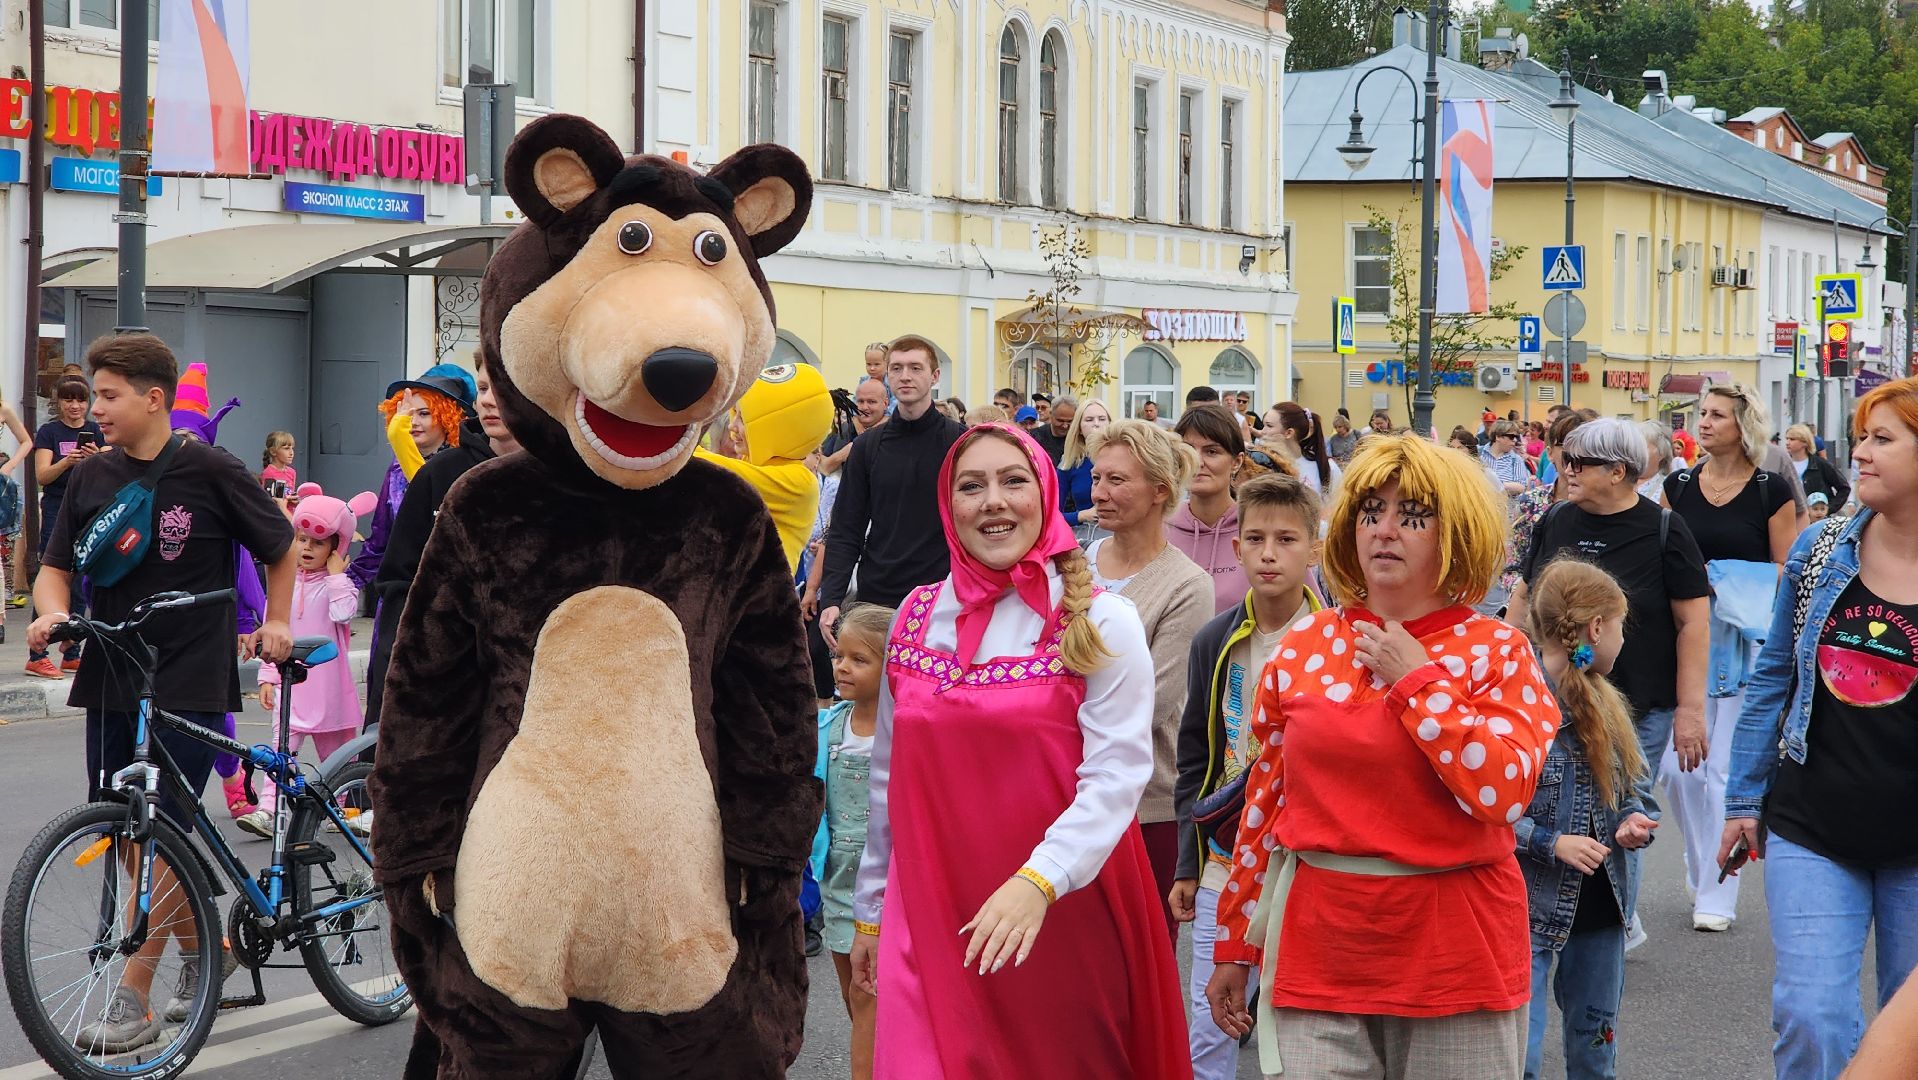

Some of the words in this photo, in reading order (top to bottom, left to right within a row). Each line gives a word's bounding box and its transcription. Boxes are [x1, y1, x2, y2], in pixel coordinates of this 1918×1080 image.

[302, 190, 344, 207] ЭКОНОМ
[345, 194, 376, 211] КЛАСС
[377, 198, 383, 211] 2
[384, 199, 409, 213] ЭТАЖ
[1142, 309, 1248, 341] ХОЗЯЮШКА
[76, 503, 127, 565] Supreme
[1866, 605, 1883, 618] SO
[1835, 631, 1861, 645] Tasty
[1864, 639, 1907, 656] Summer
[1227, 662, 1246, 716] JOURNEY
[186, 721, 248, 752] NAVIGATOR
[390, 993, 413, 1013] ELS
